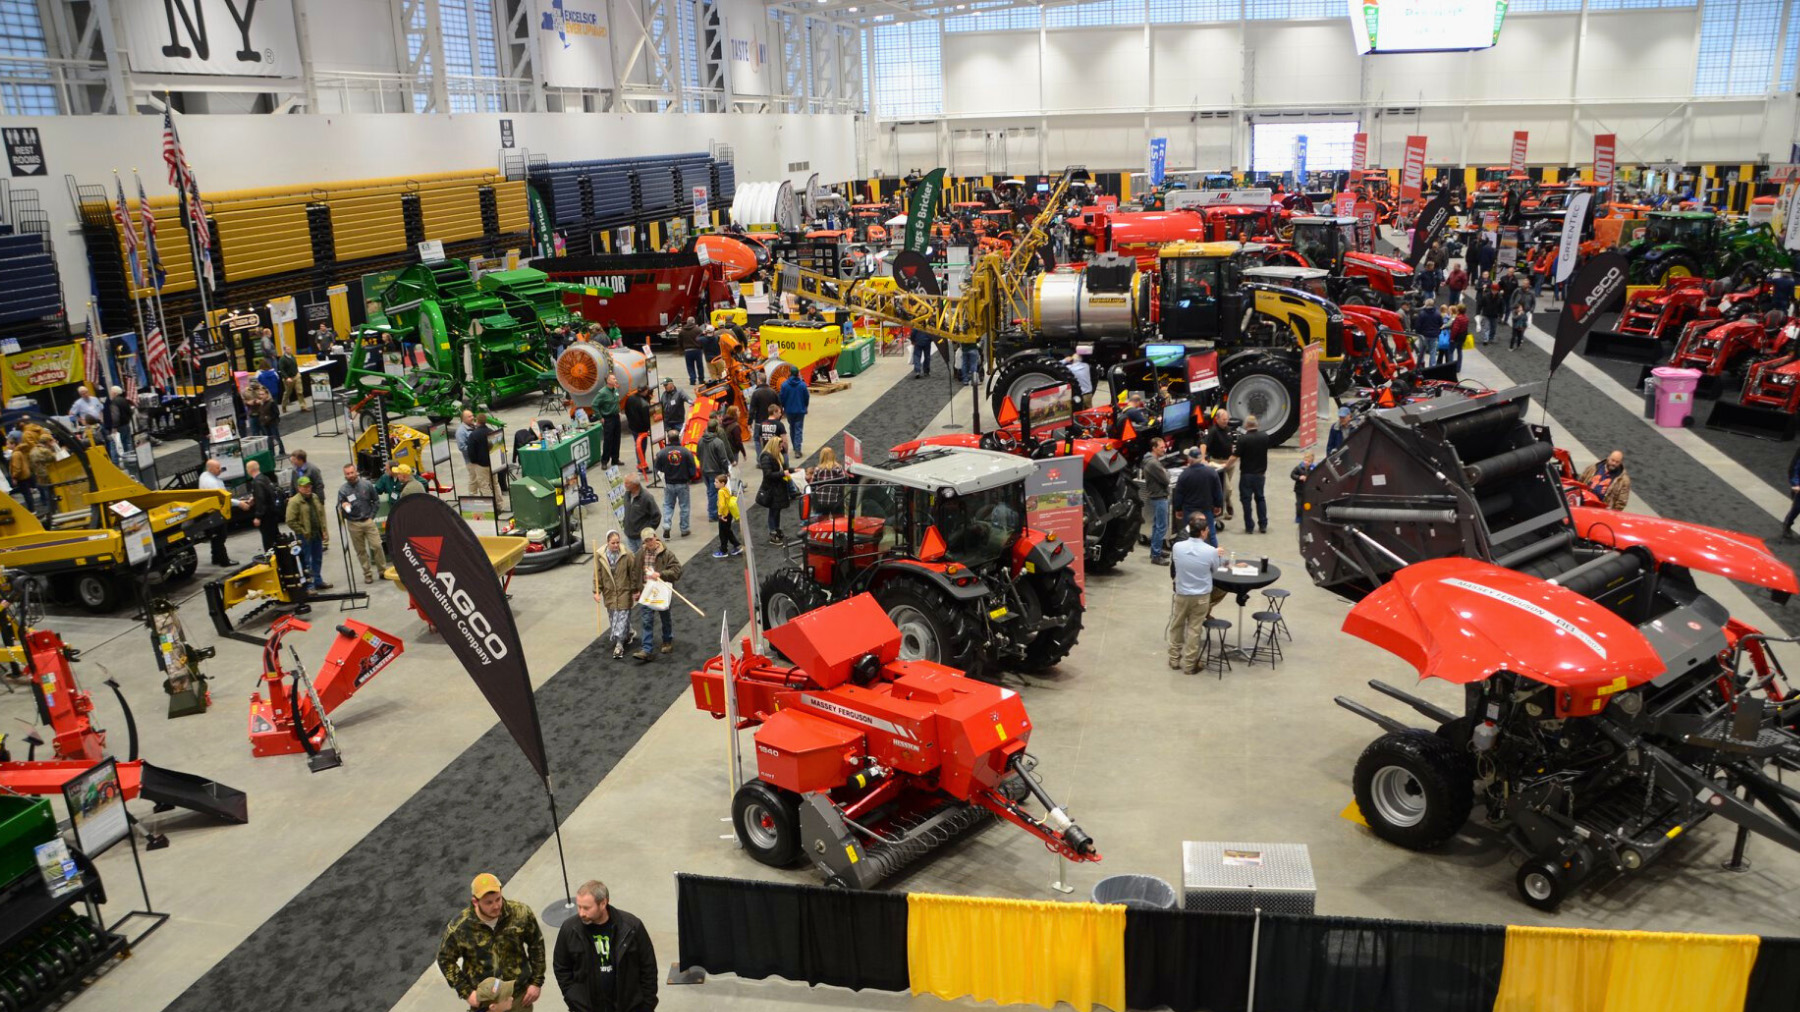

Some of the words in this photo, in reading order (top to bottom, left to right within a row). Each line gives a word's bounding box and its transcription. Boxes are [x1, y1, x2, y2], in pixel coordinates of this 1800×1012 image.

[731, 39, 749, 61] TASTE
[12, 155, 41, 164] ROOMS
[14, 146, 34, 155] REST
[1352, 141, 1366, 170] KIOTI
[1511, 140, 1526, 170] KIOTI
[1404, 146, 1425, 189] KIOTI
[921, 181, 934, 219] Bricker
[1427, 206, 1446, 232] AGCO
[1562, 204, 1580, 262] GREENTEC
[1585, 267, 1620, 306] AGCO
[777, 341, 795, 350] 1600
[797, 341, 812, 351] M1
[401, 542, 420, 567] Your
[416, 566, 458, 621] Agriculture
[457, 620, 492, 666] Company
[1457, 580, 1494, 596] MASSEY
[1495, 591, 1546, 616] FERGUSON
[436, 571, 508, 660] AGCO
[810, 698, 837, 713] MASSEY
[838, 707, 873, 725] FERGUSON
